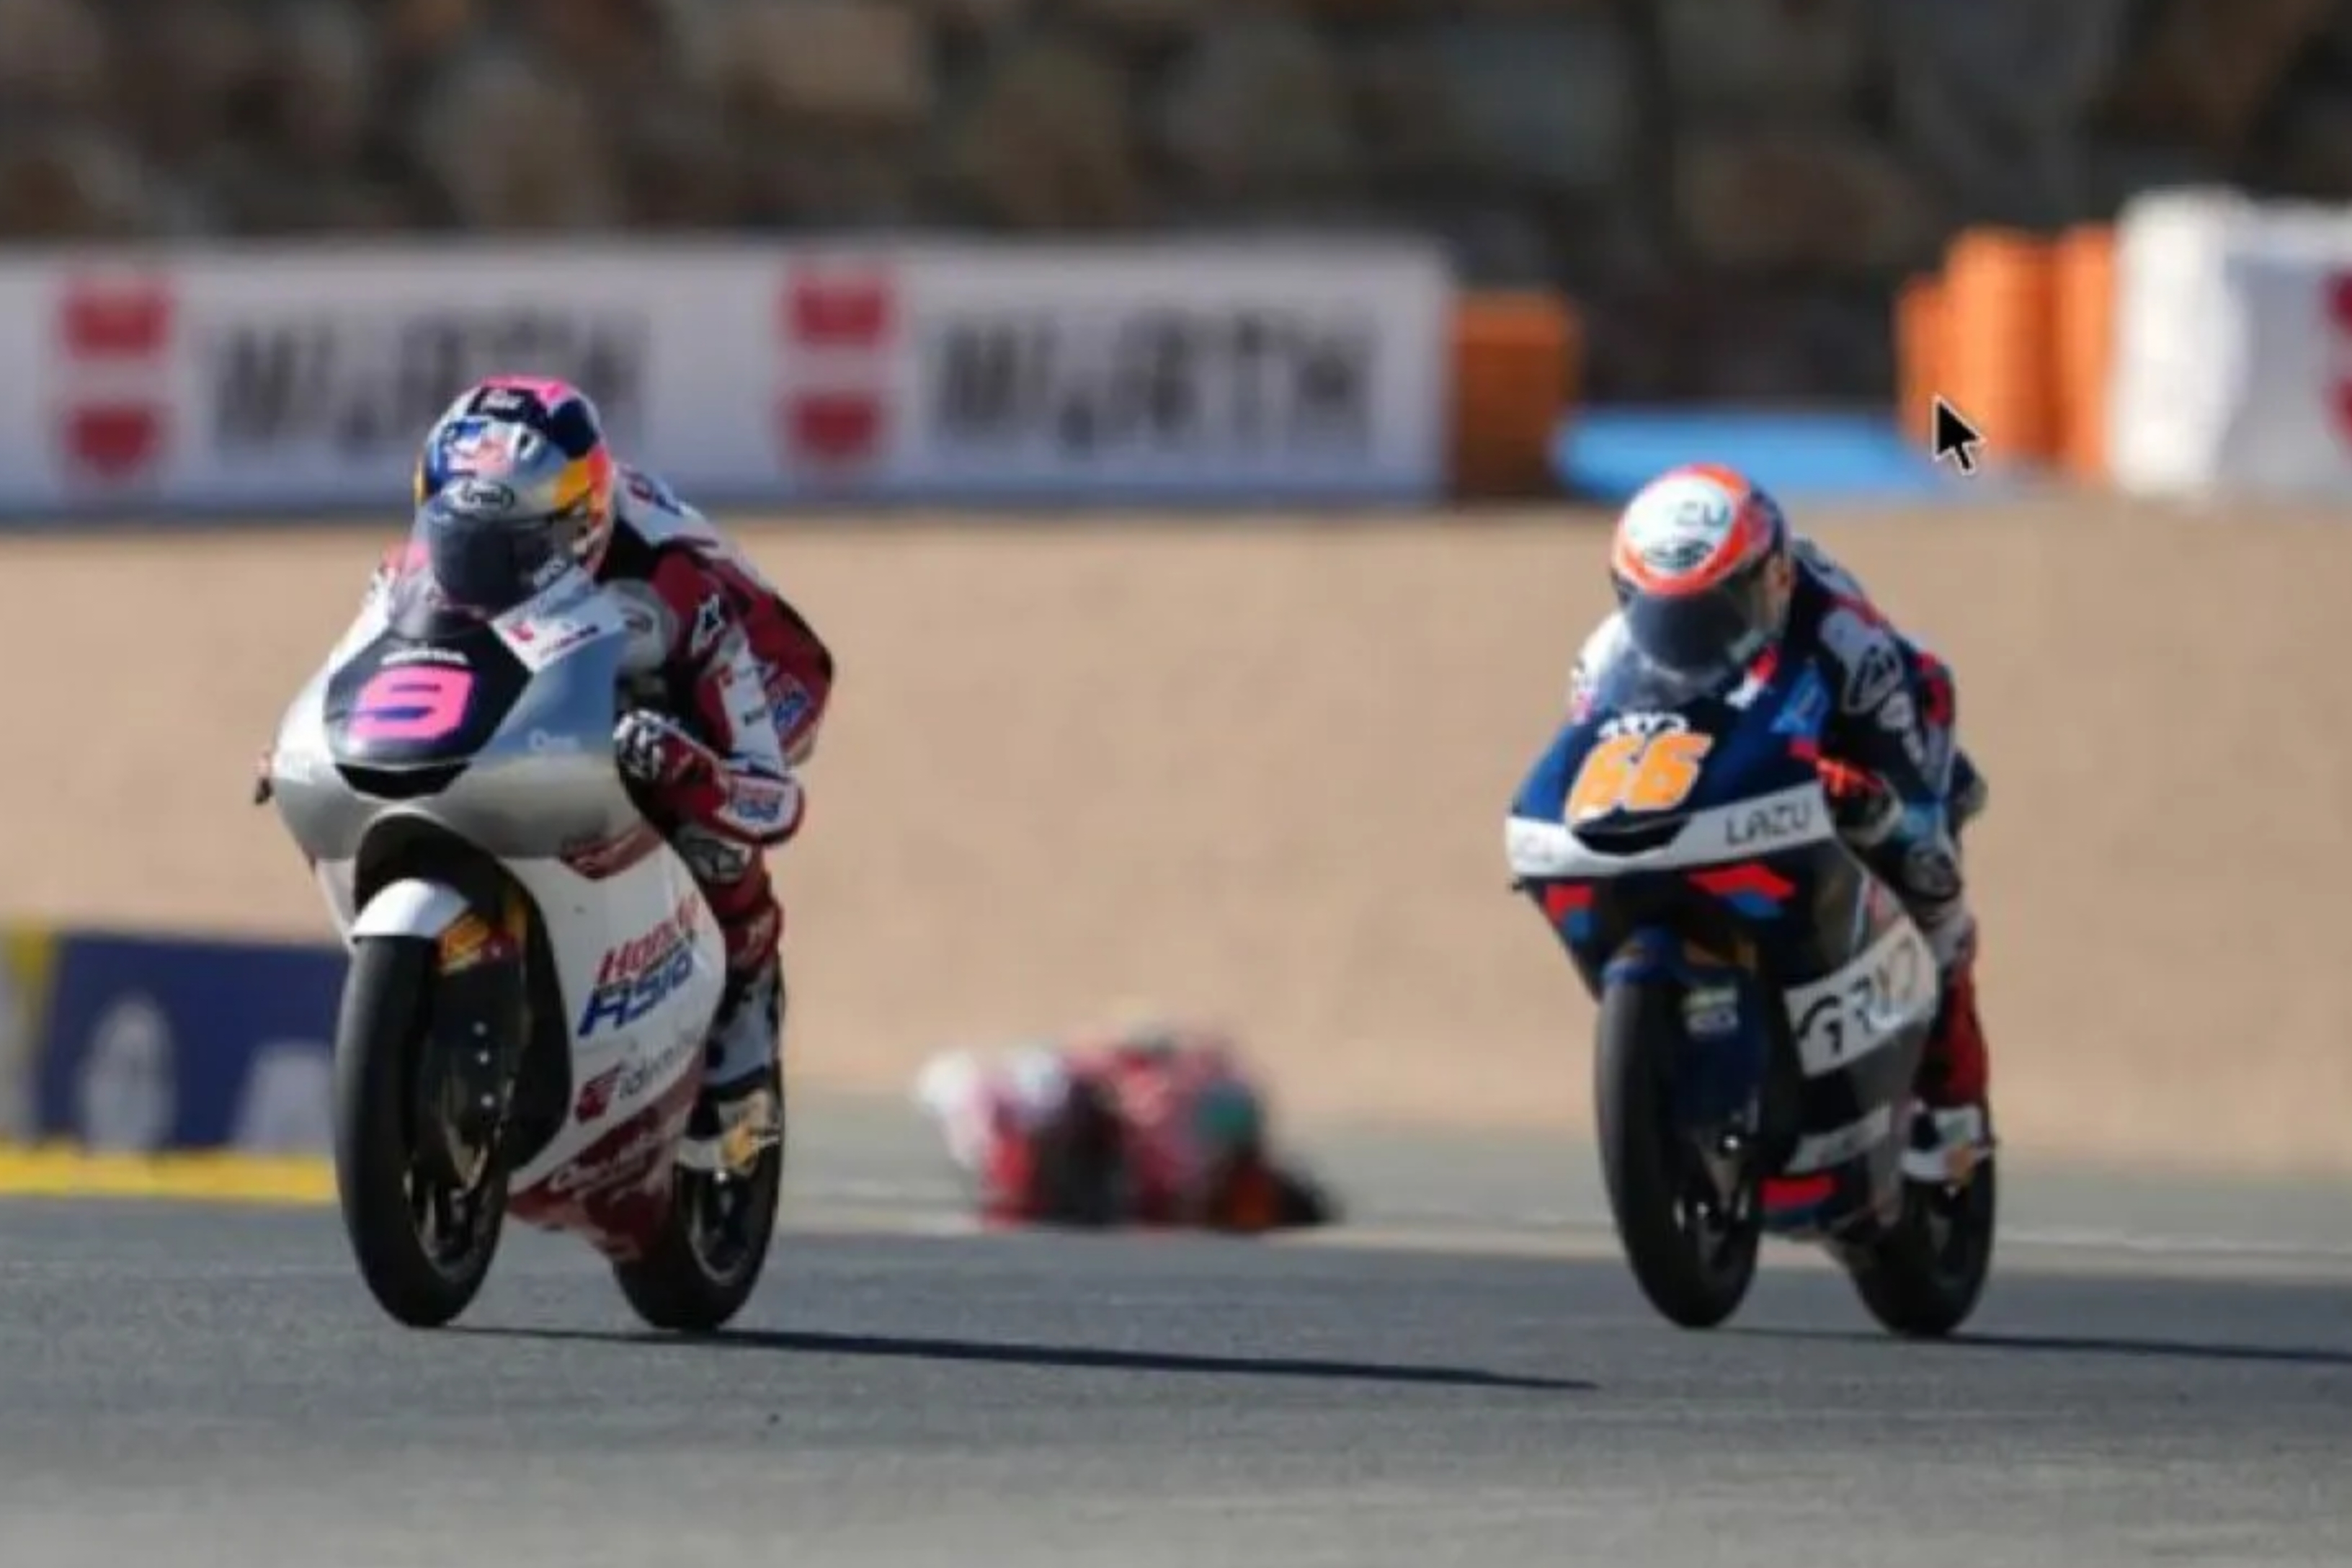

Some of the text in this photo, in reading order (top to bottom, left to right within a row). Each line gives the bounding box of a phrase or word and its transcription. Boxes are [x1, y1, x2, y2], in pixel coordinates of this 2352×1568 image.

[349, 666, 473, 741] 9
[1567, 732, 1713, 821] 66
[1727, 801, 1811, 843] LAZU
